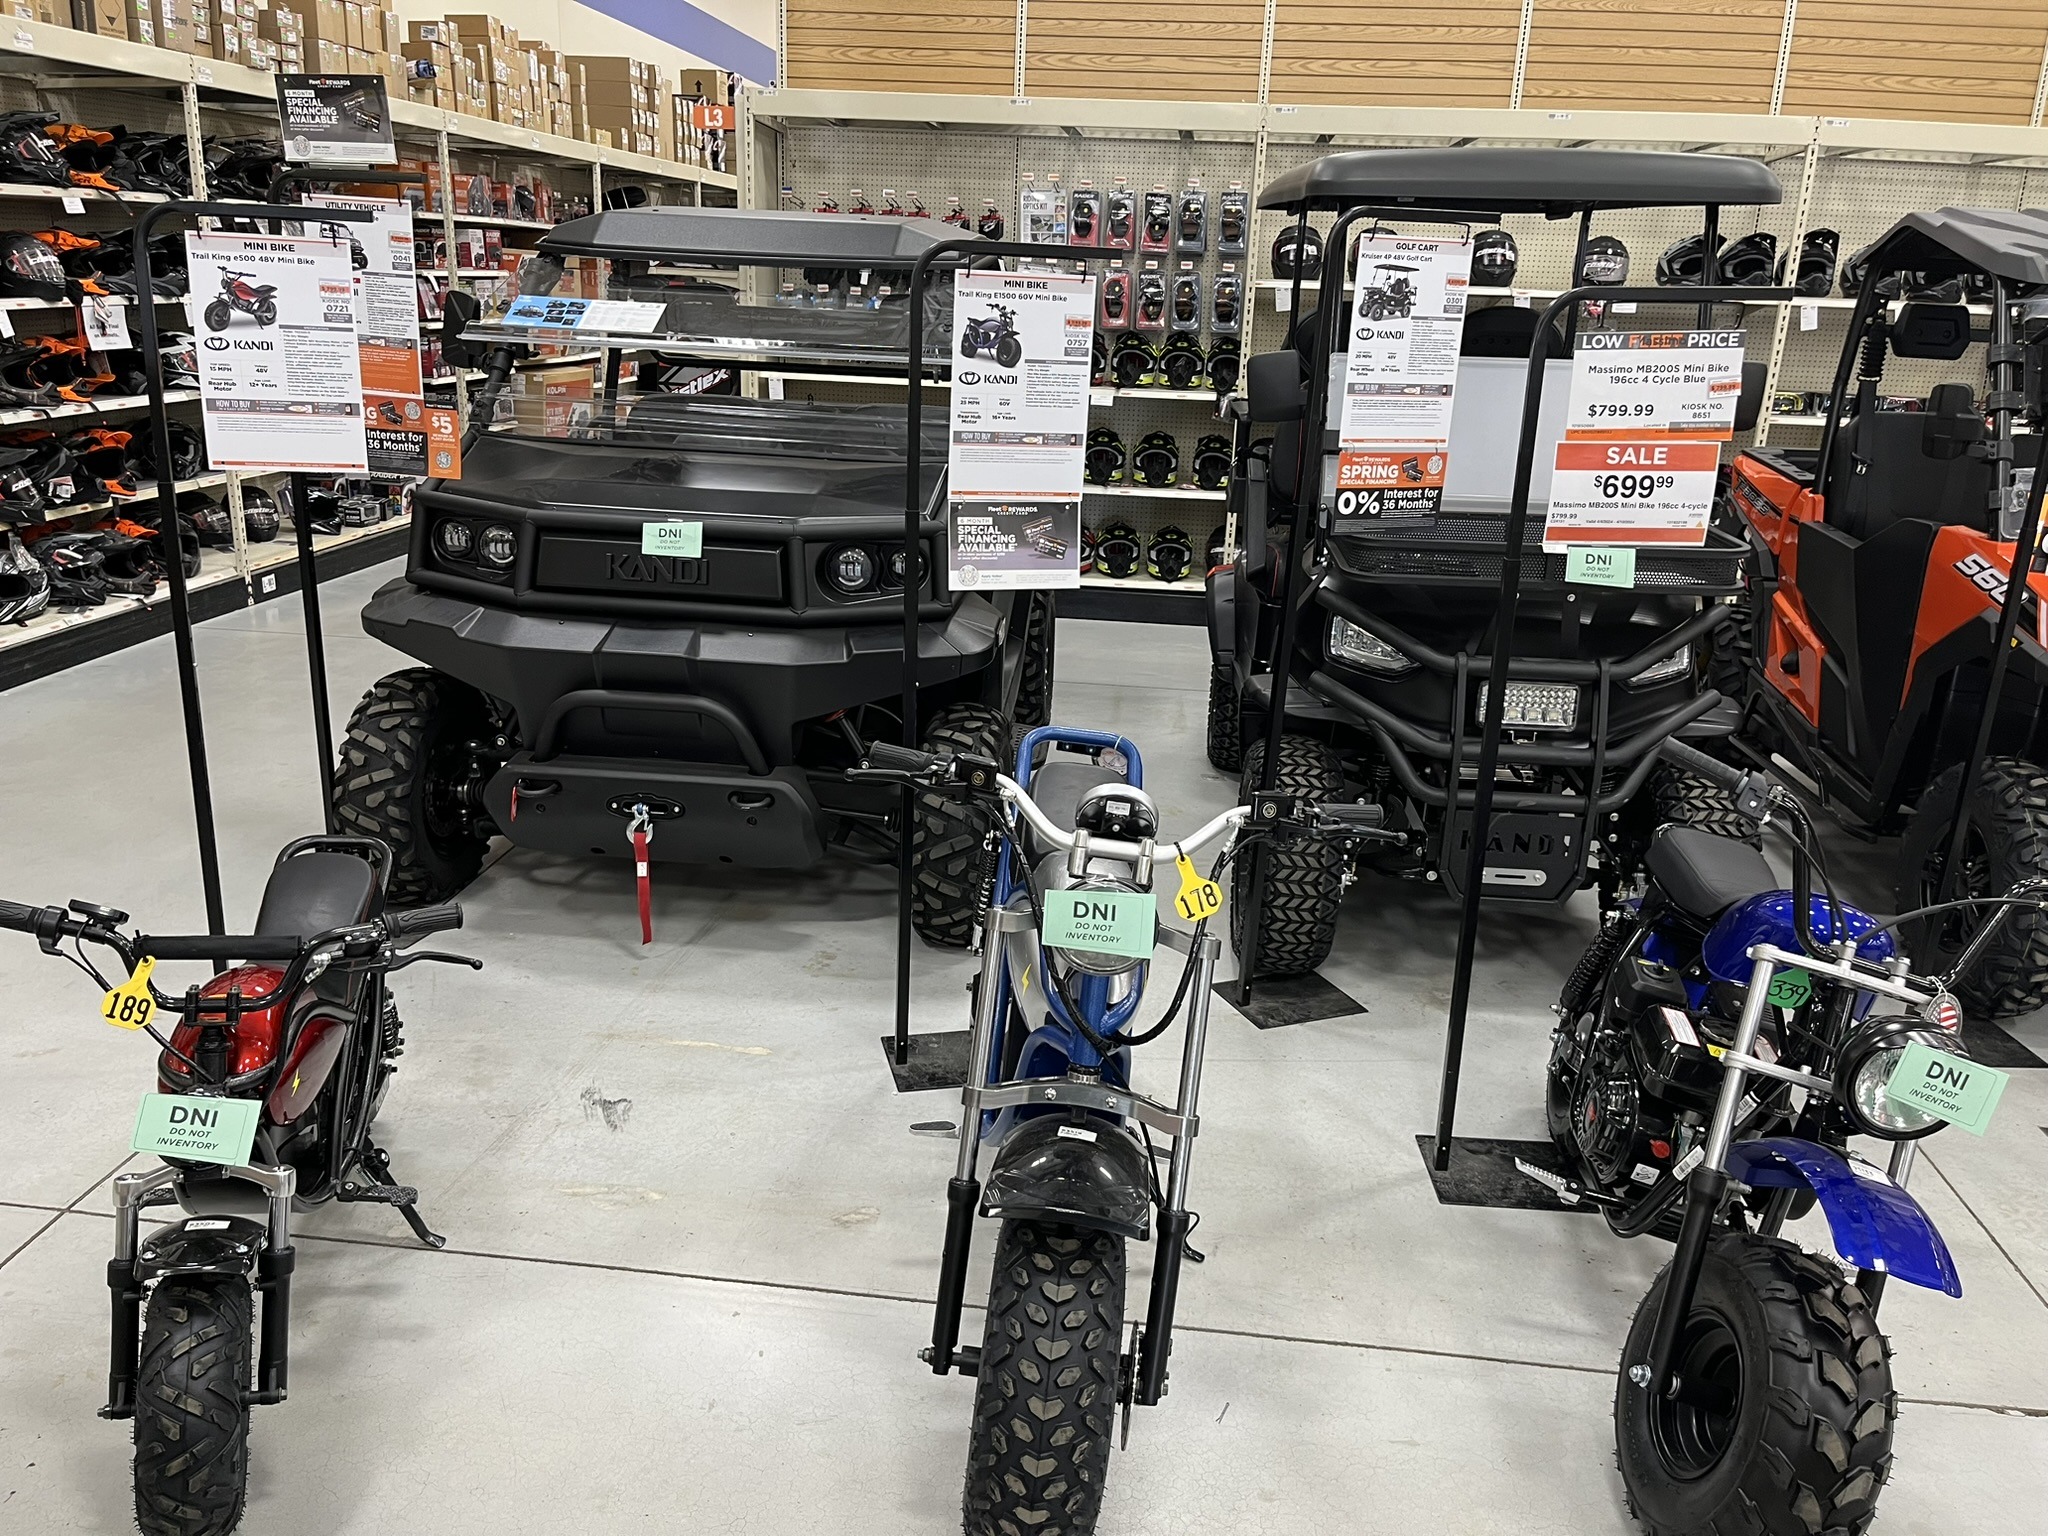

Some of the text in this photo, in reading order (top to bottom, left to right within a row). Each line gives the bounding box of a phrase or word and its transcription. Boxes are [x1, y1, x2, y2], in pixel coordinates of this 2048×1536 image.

[286, 98, 324, 107] SPECIAL
[287, 106, 337, 115] FINANCING
[704, 107, 723, 127] L3
[325, 201, 386, 212] UTILITY VEHICLE
[244, 241, 296, 253] MINI BIKE
[1395, 242, 1439, 252] GOLF CART
[191, 252, 315, 266] Trail King e500 48V Mini Bike
[393, 254, 411, 262] 0041
[1361, 252, 1383, 260] Kruiser
[1004, 279, 1049, 290] MINI BIKE
[975, 291, 992, 300] King
[993, 292, 1017, 300] E1500
[1018, 293, 1034, 301] 60V
[326, 304, 350, 313] 0721
[1376, 330, 1404, 340] KANDI
[1582, 333, 1740, 349] LOW FLEET PRICE
[234, 339, 274, 351] KANDI
[1066, 339, 1088, 347] 0757
[1588, 363, 1730, 374] Massimo MB200S Mini Bike
[984, 374, 1018, 385] KANDI
[1609, 374, 1706, 385] 196cc 4 Cycle Blue
[215, 400, 230, 408] HOW
[231, 400, 239, 408] TO
[1681, 402, 1725, 411] KIOSK NO.
[1587, 403, 1655, 418] $799.99
[1692, 411, 1711, 419] 8651
[431, 416, 453, 434] $5
[367, 429, 423, 442] Interest for
[367, 440, 380, 449] 36
[1605, 446, 1669, 465] SALE
[1340, 465, 1399, 479] SPRING
[1384, 487, 1439, 499] Interest for
[1337, 490, 1380, 516] 0%
[1382, 499, 1396, 510] 36
[1552, 501, 1587, 509] Massimo
[1588, 501, 1619, 509] MB200S
[1638, 502, 1656, 510] Bike
[1657, 502, 1680, 510] 196cc
[1681, 502, 1708, 511] 4-cycle
[658, 528, 682, 539] DNI
[957, 525, 1001, 535] SPECIAL
[957, 534, 1016, 544] FINANCING
[1585, 553, 1612, 567] DNI
[606, 553, 709, 585] KANDI
[1180, 883, 1219, 920] 178
[1073, 901, 1117, 922] DNI
[1074, 922, 1114, 933] DO NOT
[1065, 931, 1122, 944] INVENTORY
[1768, 979, 1808, 1007] 339
[105, 991, 152, 1026] 189
[1925, 1060, 1971, 1092] DNI
[1922, 1081, 1960, 1100] DO NOT
[1908, 1088, 1963, 1113] INVENTORY
[169, 1105, 219, 1128] DNI
[169, 1127, 212, 1139] DO NOT
[156, 1137, 220, 1151] INVENTORY
